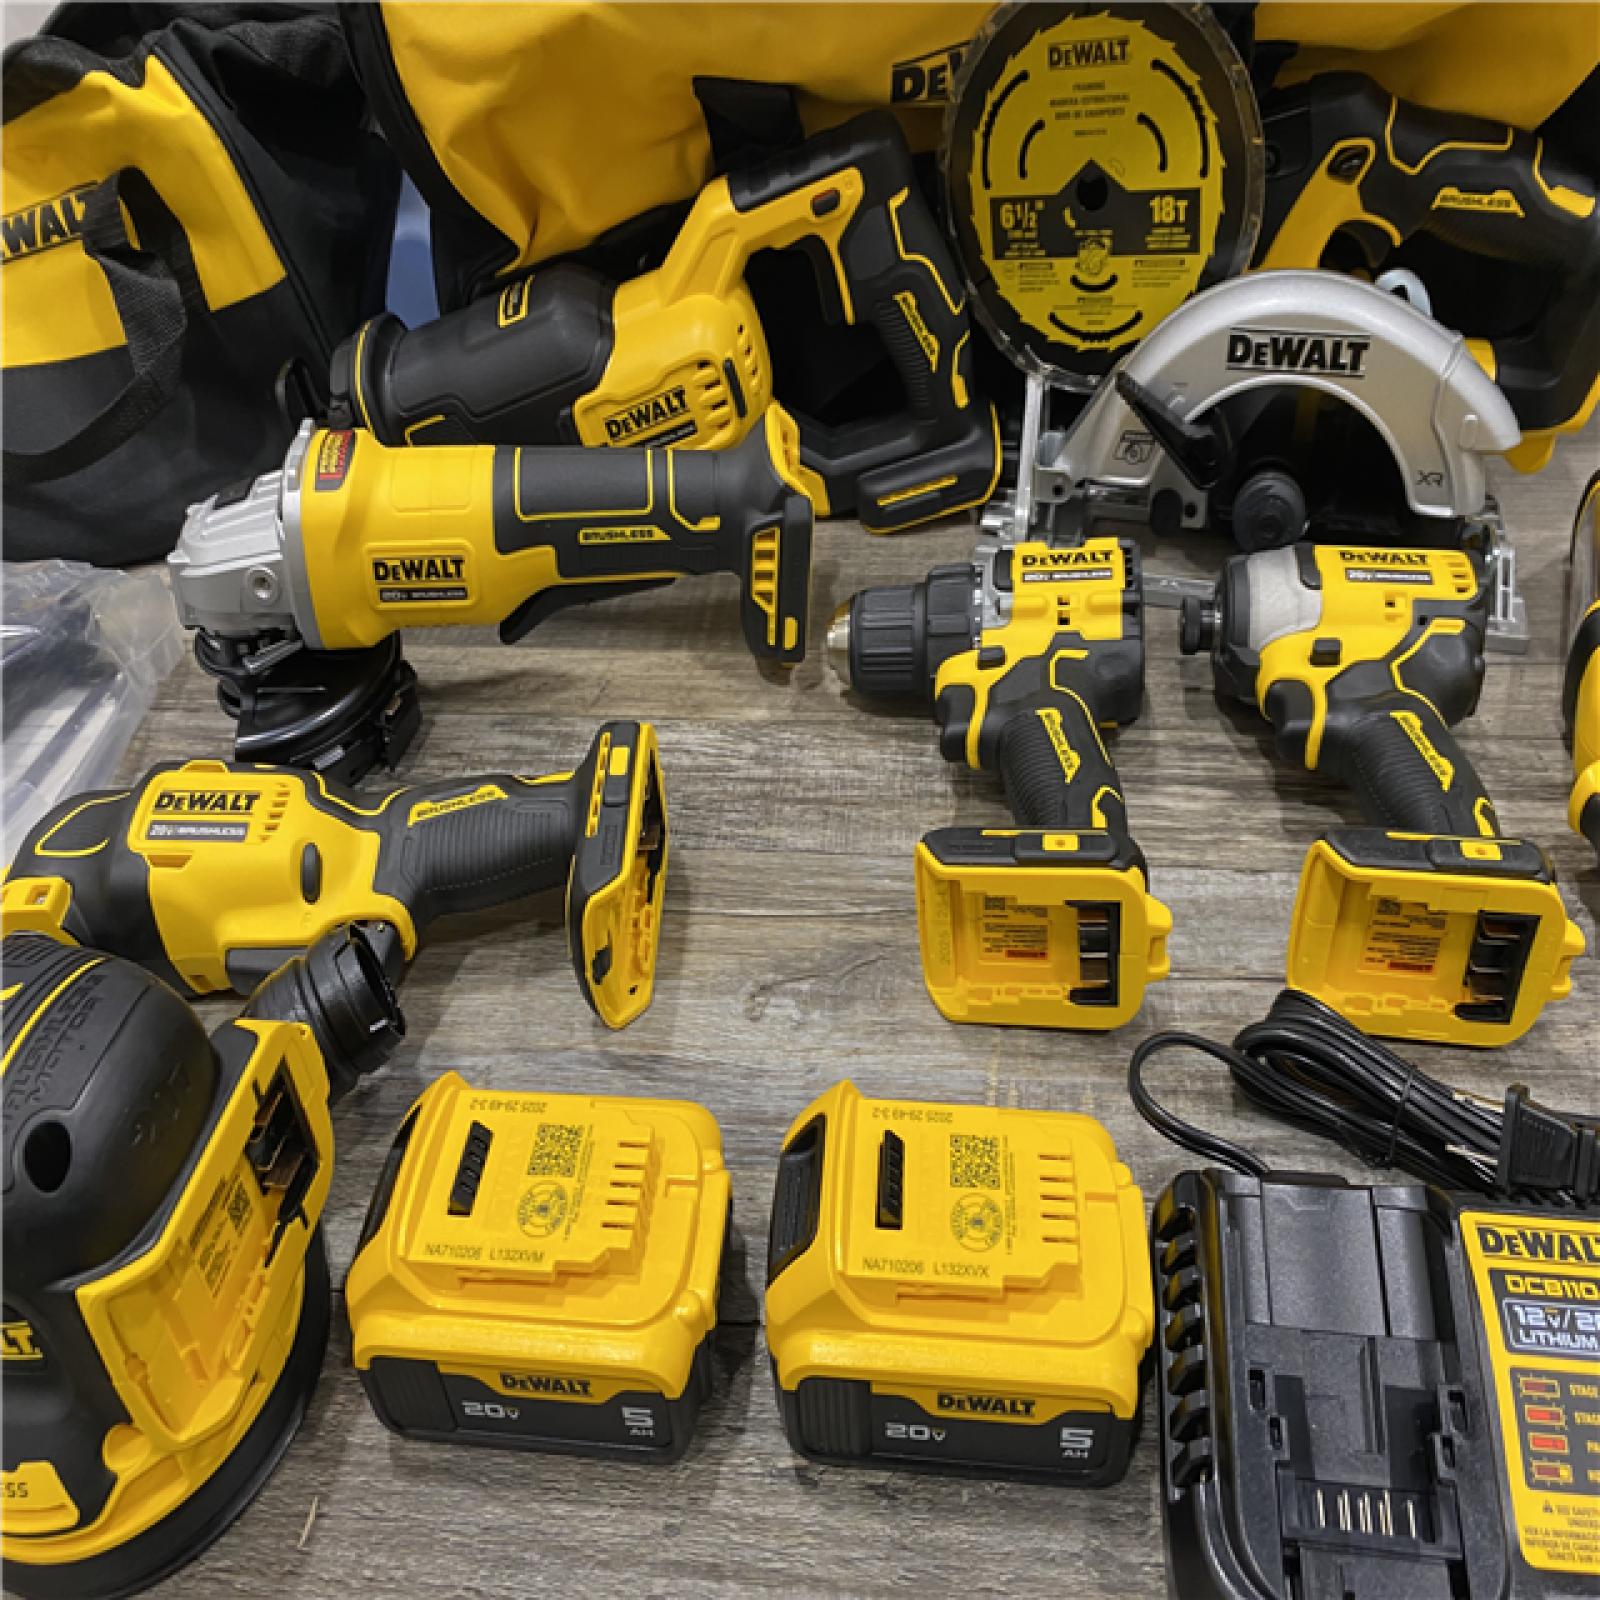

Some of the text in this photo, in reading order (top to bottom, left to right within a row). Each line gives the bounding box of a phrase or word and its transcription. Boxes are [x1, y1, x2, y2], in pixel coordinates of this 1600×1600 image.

[1048, 39, 1130, 67] DEWALT
[1149, 195, 1189, 224] 18T
[1227, 333, 1370, 371] DEWALT
[604, 386, 687, 440] DEWALT
[373, 557, 465, 581] DEWALT
[1022, 550, 1112, 567] DEWALT
[1339, 550, 1429, 565] DEWALT
[154, 792, 261, 812] DEWALT
[1477, 1226, 1600, 1263] DEWAL
[501, 1374, 591, 1395] DEWALT
[621, 1406, 654, 1426] 5
[937, 1392, 1036, 1417] DEWALT
[1060, 1427, 1094, 1449] 5
